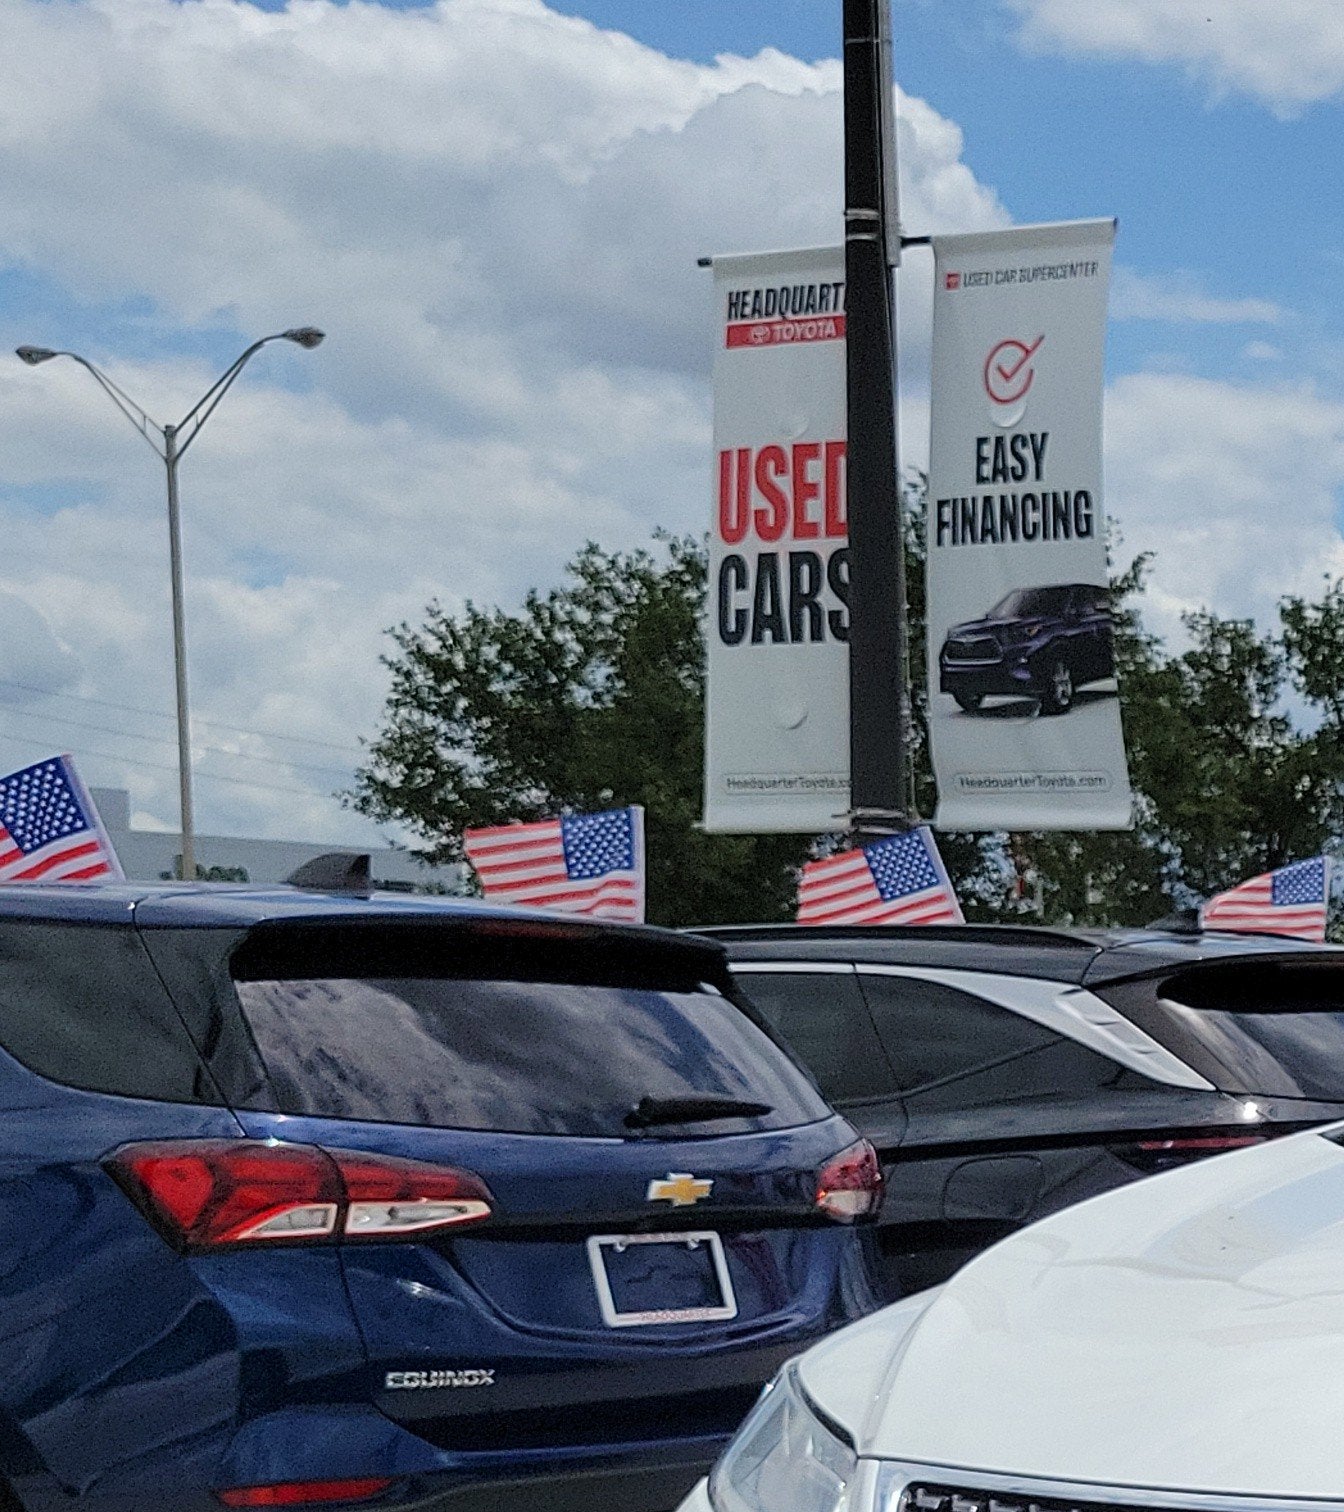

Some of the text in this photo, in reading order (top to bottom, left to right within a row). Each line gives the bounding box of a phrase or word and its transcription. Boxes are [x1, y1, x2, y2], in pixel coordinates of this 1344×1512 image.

[963, 262, 1098, 287] USED CAR SUPERCENTER
[728, 282, 845, 320] HEADQUART
[773, 319, 836, 341] TOYOTA
[976, 432, 1049, 484] EASY
[720, 441, 847, 543] USED
[937, 490, 1094, 546] FINANCING
[719, 547, 849, 646] CARS
[386, 1369, 495, 1389] EQUINOX
